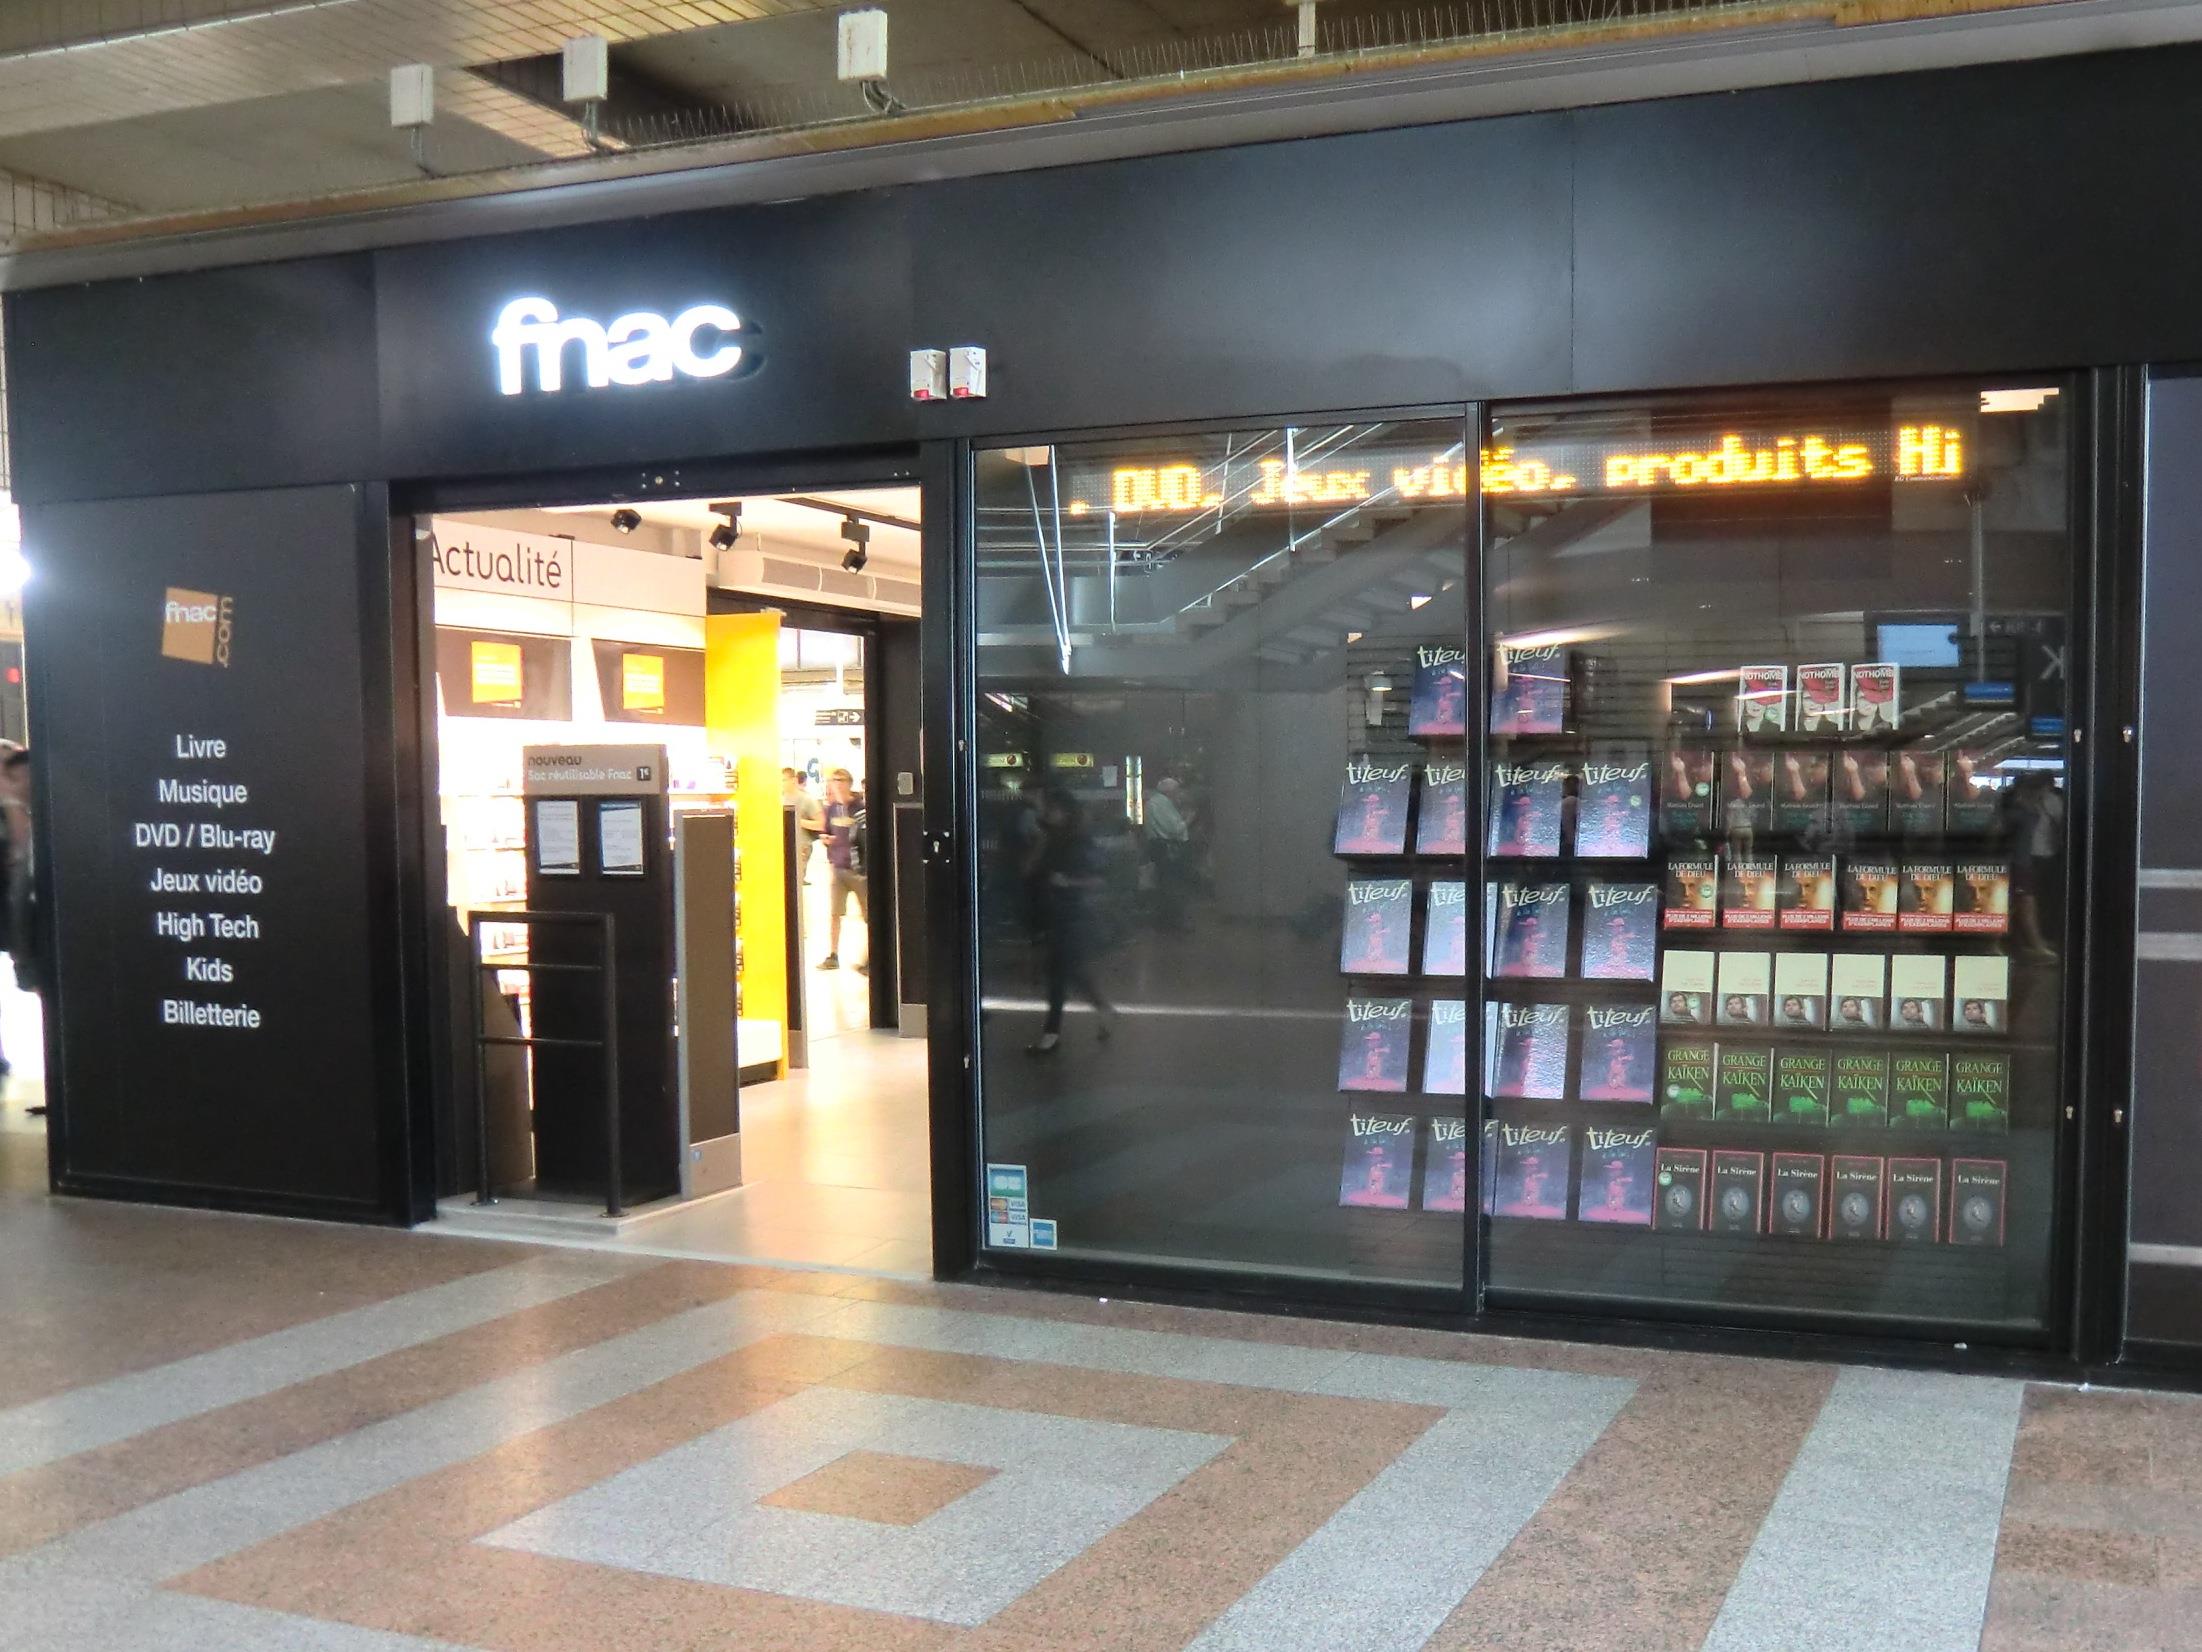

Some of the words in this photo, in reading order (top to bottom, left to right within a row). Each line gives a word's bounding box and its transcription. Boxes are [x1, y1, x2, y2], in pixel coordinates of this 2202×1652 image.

[492, 297, 742, 395] fnac
[1606, 434, 1872, 486] produits
[1899, 425, 1962, 474] Hi
[433, 534, 562, 588] Actualité
[165, 600, 216, 624] fnac
[1418, 645, 1465, 669] titeu
[1497, 642, 1558, 666] titeuf
[176, 734, 226, 758] Livre
[528, 755, 582, 766] nouveau
[1346, 762, 1409, 786] titeuf
[1495, 762, 1560, 788] titeuf
[1581, 762, 1648, 786] titeuf
[158, 778, 248, 808] Musique
[134, 823, 181, 848] DVD
[199, 825, 276, 855] Blu-ray
[150, 867, 200, 893] Jeux
[204, 868, 263, 894] vidéo
[1348, 882, 1409, 905] titeuf
[1502, 883, 1563, 908] titeuf
[1588, 884, 1652, 909] titeuf
[156, 911, 204, 942] High
[208, 913, 259, 939] Tech
[186, 957, 234, 983] Kids
[163, 999, 260, 1029] Billetterie
[1346, 999, 1409, 1025] titeuf
[1501, 1003, 1564, 1028] titeuf
[1587, 1005, 1651, 1029] titeuf
[1668, 1050, 1710, 1061] GRANGE
[1722, 1055, 1766, 1067] GRANGE
[1780, 1057, 1825, 1070] GRANGE
[1837, 1058, 1883, 1071] GRANGE
[1896, 1060, 1942, 1072] GRANGE
[1956, 1061, 2002, 1073] GRANGE
[1668, 1064, 1709, 1080] KAÏKEN
[1723, 1070, 1766, 1085] KAÏKEN
[1780, 1073, 1825, 1088] KAÏKEN
[1838, 1074, 1883, 1090] KAÏKEN
[1896, 1076, 1942, 1091] KAÏKEN
[1956, 1077, 2002, 1093] KAÏKEN
[1350, 1113, 1412, 1136] titeuf
[1502, 1122, 1564, 1147] titeuf
[1586, 1126, 1652, 1150] titeuf
[1661, 1163, 1672, 1171] La
[1717, 1166, 1728, 1175] La
[1778, 1168, 1788, 1177] La
[1836, 1171, 1847, 1179] La
[1893, 1173, 1904, 1182] La
[1958, 1175, 1969, 1184] La
